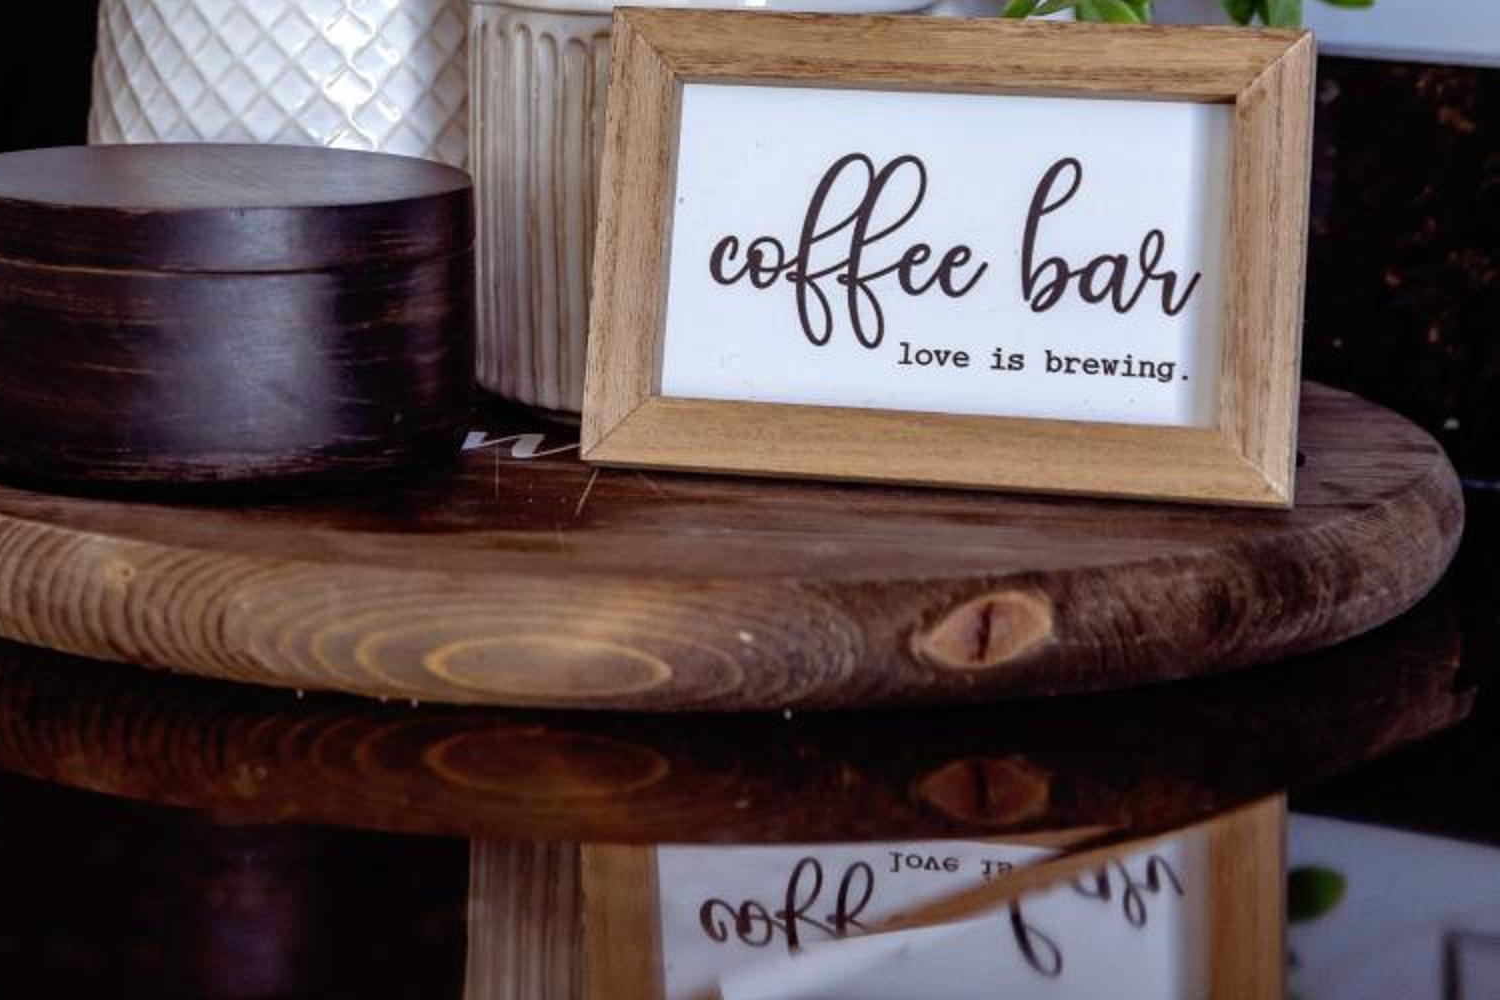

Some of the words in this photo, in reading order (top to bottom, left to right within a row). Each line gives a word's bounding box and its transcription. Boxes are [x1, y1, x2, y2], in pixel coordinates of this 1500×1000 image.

[708, 151, 990, 350] coffee
[1020, 156, 1203, 318] bar
[896, 342, 971, 368] love
[989, 348, 1026, 372] is
[1045, 349, 1191, 384] brewing.
